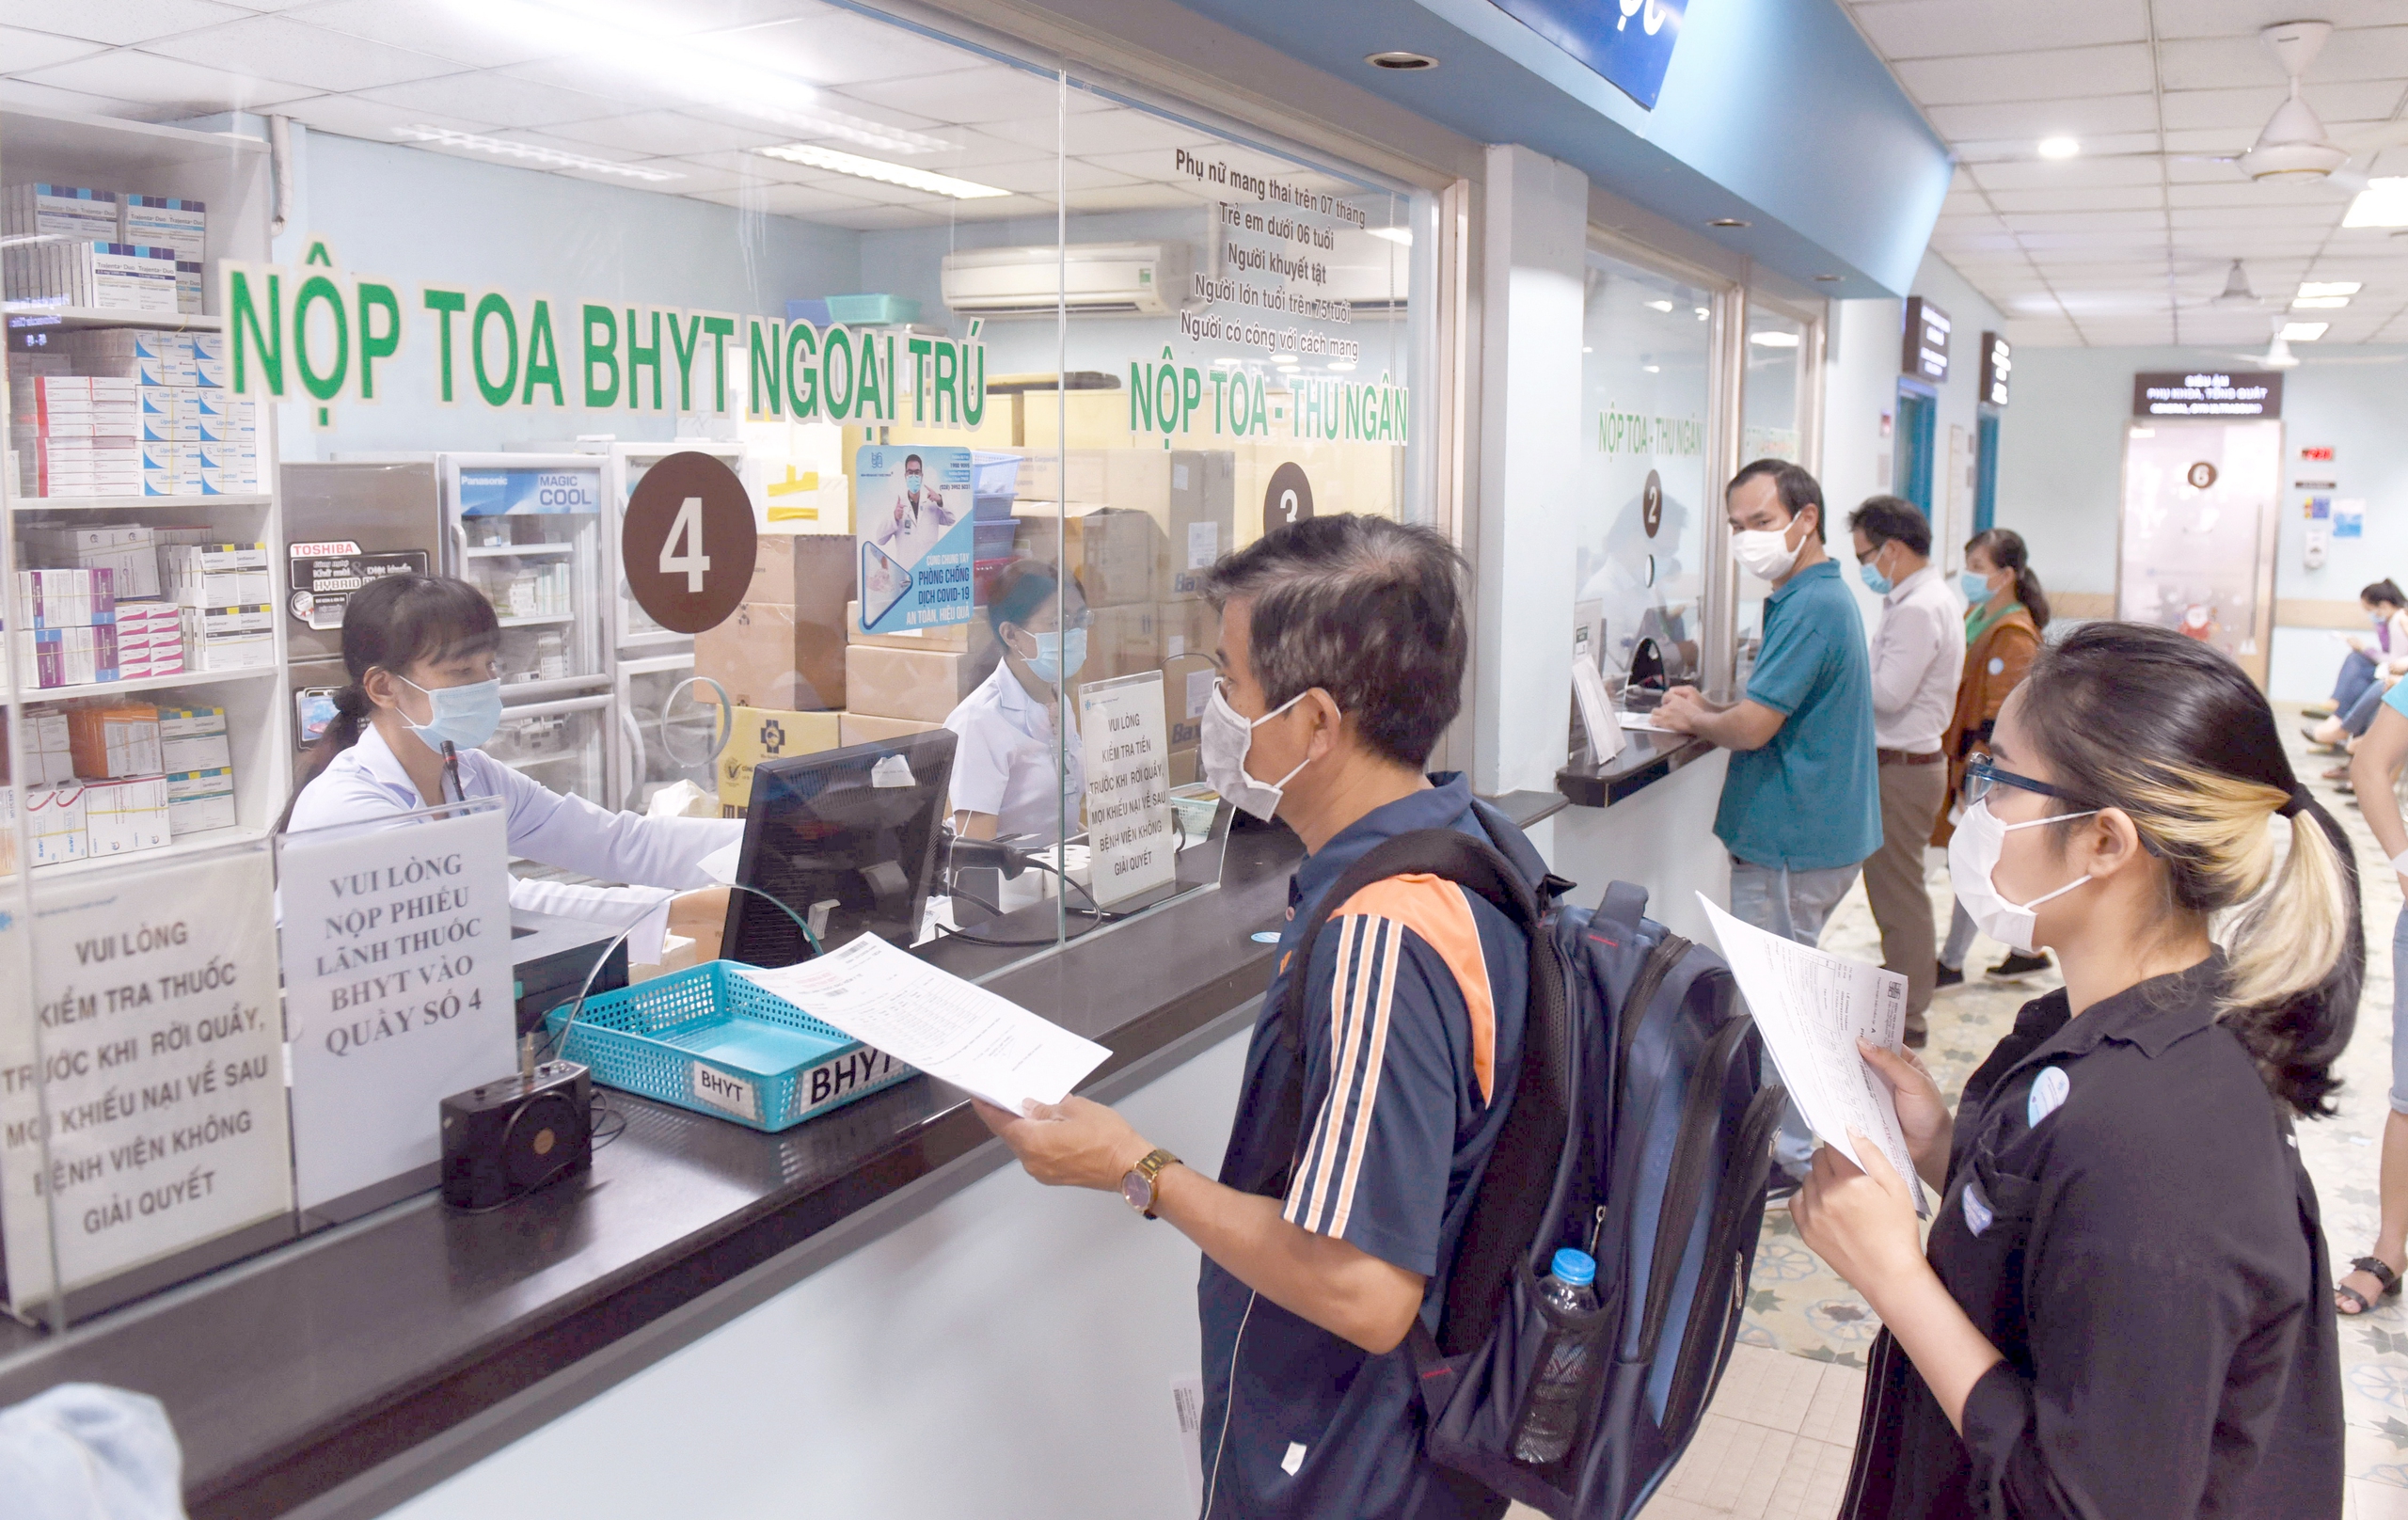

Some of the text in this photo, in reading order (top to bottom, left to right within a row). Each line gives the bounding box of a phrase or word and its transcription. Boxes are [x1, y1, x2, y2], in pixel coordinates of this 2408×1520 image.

[1176, 149, 1366, 230] Phụ nữ mang thai trên 07 tháng
[1219, 201, 1335, 250] Trẻ em dưới 06 tuổi
[1228, 242, 1327, 287] Người khuyết tật
[1195, 273, 1352, 324] Người lớn tuổi trên 75 tuổi
[230, 242, 985, 442] NỘP TOA BHYT NGOẠI TRÚ
[1180, 311, 1359, 362] Người có công với cách mạng
[1131, 345, 1407, 450] NỘP TOA - THU NGÂN
[1599, 401, 1624, 463] NỘP
[1626, 414, 1647, 454] TOA
[1656, 417, 1675, 455] THU
[1677, 412, 1703, 455] NGÂN
[461, 476, 578, 486] Panasonic MAGIC
[540, 489, 592, 506] COOL
[1648, 485, 1657, 524] 2
[293, 543, 354, 556] TOSHIBA
[659, 497, 710, 594] 4
[313, 578, 361, 592] HYBRID
[918, 563, 970, 586] PHÒNG CHỐNG
[918, 589, 936, 607] DỊCH
[906, 601, 970, 625] AN TOÀN, HIỆU QUẢ
[1108, 711, 1140, 733] VUI LÒNG
[1102, 735, 1151, 764] KIỂM TRA TIỀN
[1090, 775, 1115, 794] TRƯỚC
[1116, 772, 1128, 790] KHI
[1131, 767, 1143, 784] RỜI
[1091, 789, 1166, 826] MỌI KHIẾU NẠI VỀ SAU
[1100, 819, 1163, 852] BỆNH VIỆN KHÔNG
[330, 852, 463, 899] VUI LÒNG
[1114, 846, 1152, 877] GIẢI QUYẾT
[325, 886, 469, 941] NỘP PHIẾU
[76, 920, 189, 967] VUI LÒNG
[316, 918, 482, 978] LÃNH THUỐC
[39, 956, 236, 1028] KIỂM TRA THUỐC
[330, 954, 474, 1014] BHYT VÀO
[423, 988, 461, 1026] SỐ
[467, 988, 482, 1012] 4
[2, 1046, 89, 1095] TRỚC
[97, 1039, 137, 1071] KHI
[150, 1023, 192, 1058] RỜI
[60, 1085, 135, 1135] KHIẾU
[142, 1081, 182, 1115] NẠI
[189, 1063, 215, 1098] VỀ
[224, 1053, 269, 1089] SAU
[702, 1069, 743, 1102] BHYT
[110, 1133, 166, 1173] VIỆN
[172, 1109, 252, 1154] KHÔNG
[84, 1168, 215, 1236] GIẢI QUYẾT
